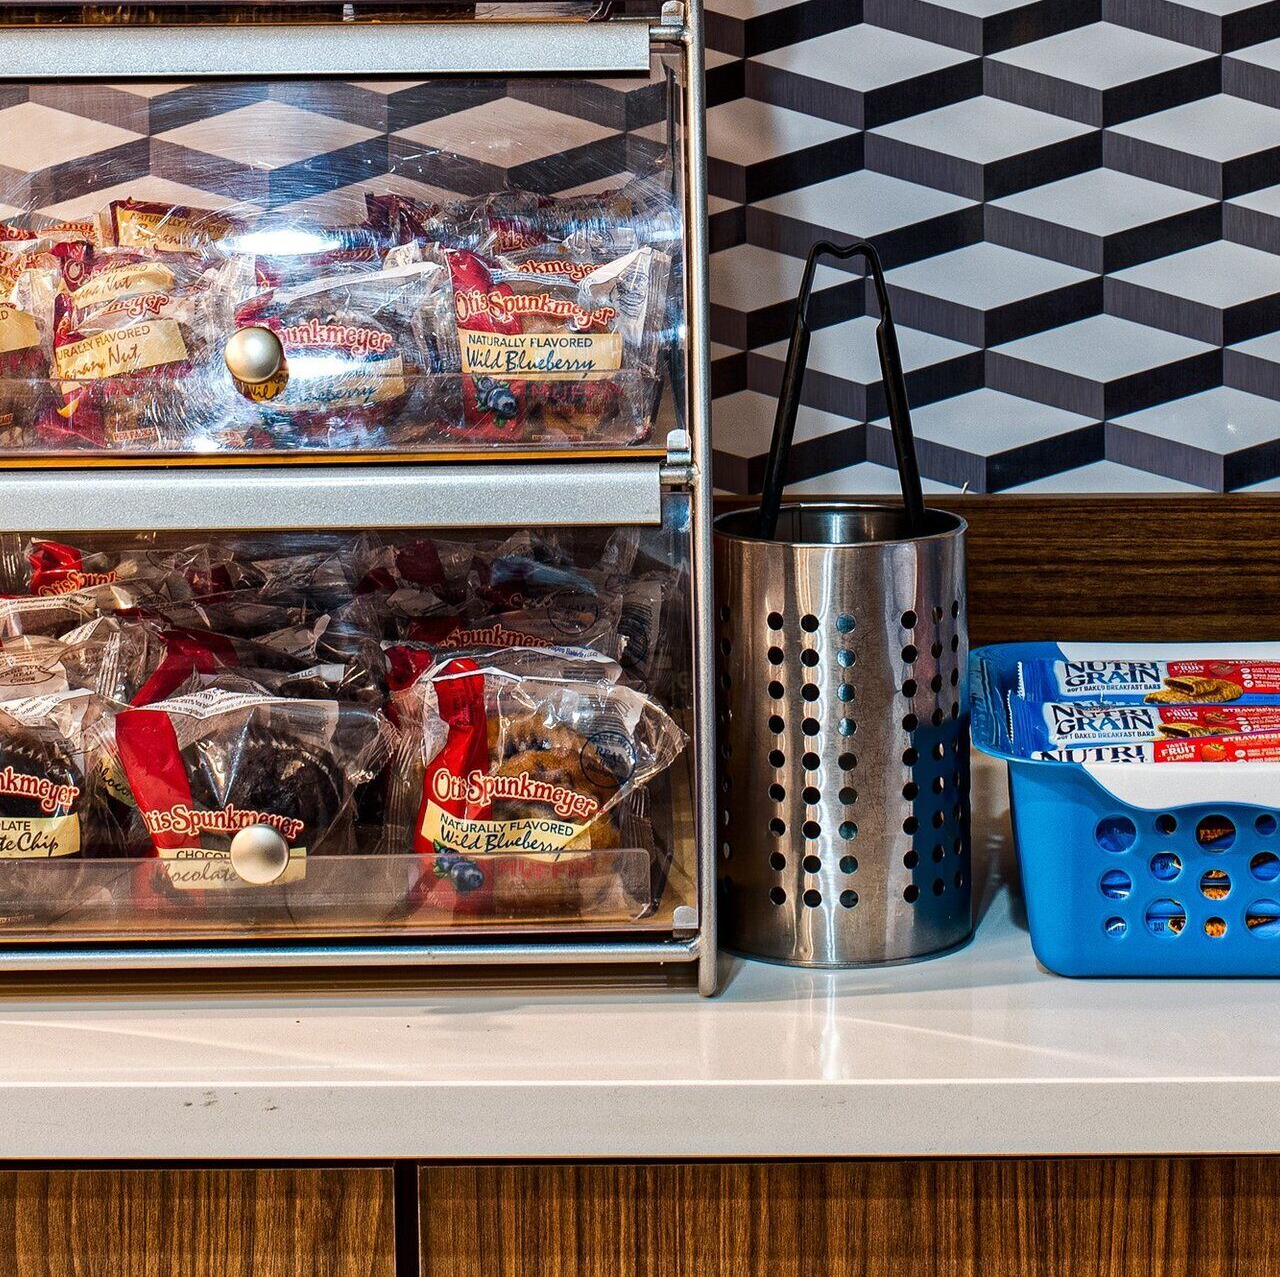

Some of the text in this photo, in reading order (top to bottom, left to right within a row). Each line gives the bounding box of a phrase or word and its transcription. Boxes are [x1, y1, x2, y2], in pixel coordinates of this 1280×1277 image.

[277, 317, 394, 358] unkmeyer
[468, 333, 594, 348] NATURALLY FLAVORED
[56, 341, 96, 362] URALLY
[466, 346, 597, 379] Wild Blueberry
[1064, 660, 1160, 672] NUTRI
[1064, 670, 1162, 687] GRAIN
[1106, 683, 1142, 691] BREAKFAST
[1051, 704, 1150, 722] NUTRI
[1056, 719, 1155, 736] GRAIN
[1074, 732, 1097, 740] BAKED
[1097, 731, 1137, 739] BREAKFAST
[1137, 730, 1156, 738] BARS
[1040, 746, 1144, 763] NUTRI
[1160, 745, 1196, 756] FRUIT
[1166, 753, 1195, 761] FLAVOR
[432, 767, 598, 817] Otis Spunkmeyer
[146, 808, 171, 834] tis
[440, 812, 575, 837] NATURALLY FLAVORED
[16, 830, 60, 857] Chip
[440, 825, 568, 862] Wild Blueberry
[163, 861, 240, 883] hocolate
[1153, 921, 1165, 931] BAR
